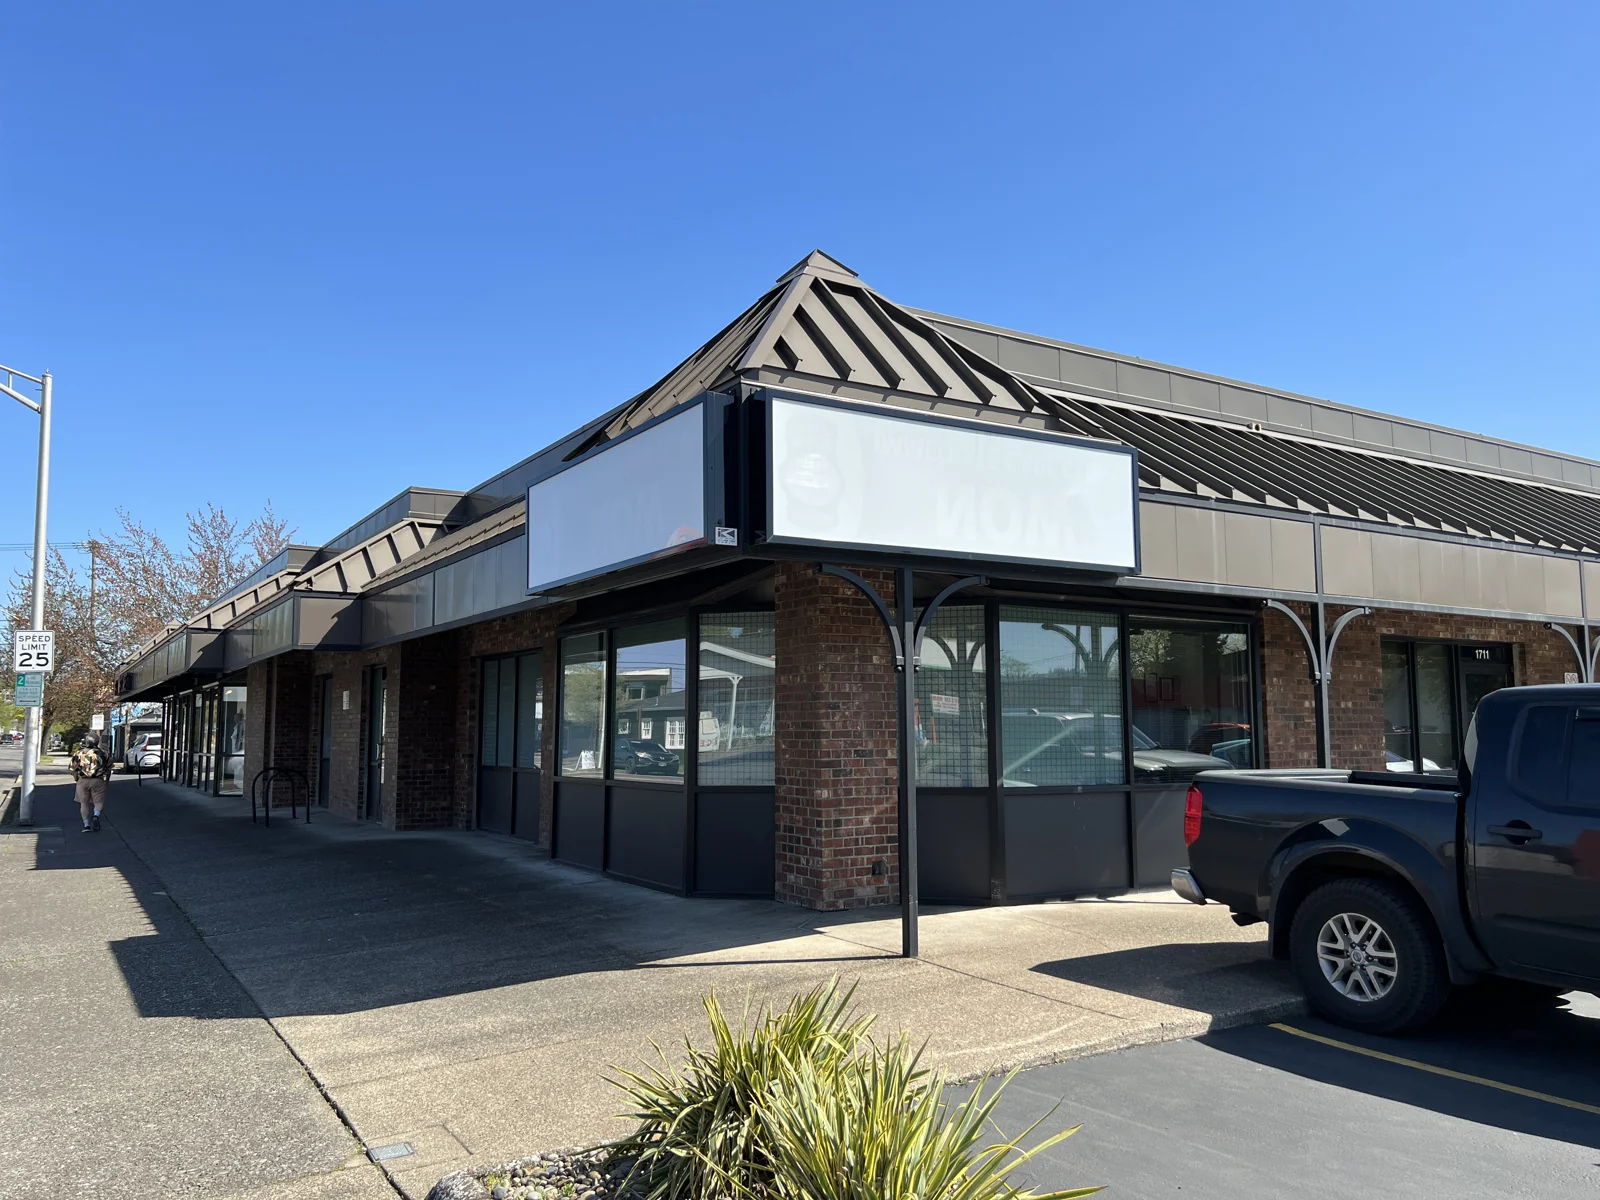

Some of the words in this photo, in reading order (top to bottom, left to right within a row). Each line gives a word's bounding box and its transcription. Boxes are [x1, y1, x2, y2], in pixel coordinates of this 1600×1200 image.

[21, 643, 47, 651] LIMIT
[18, 652, 49, 667] 25
[1475, 649, 1489, 660] 1711
[17, 675, 24, 685] 2
